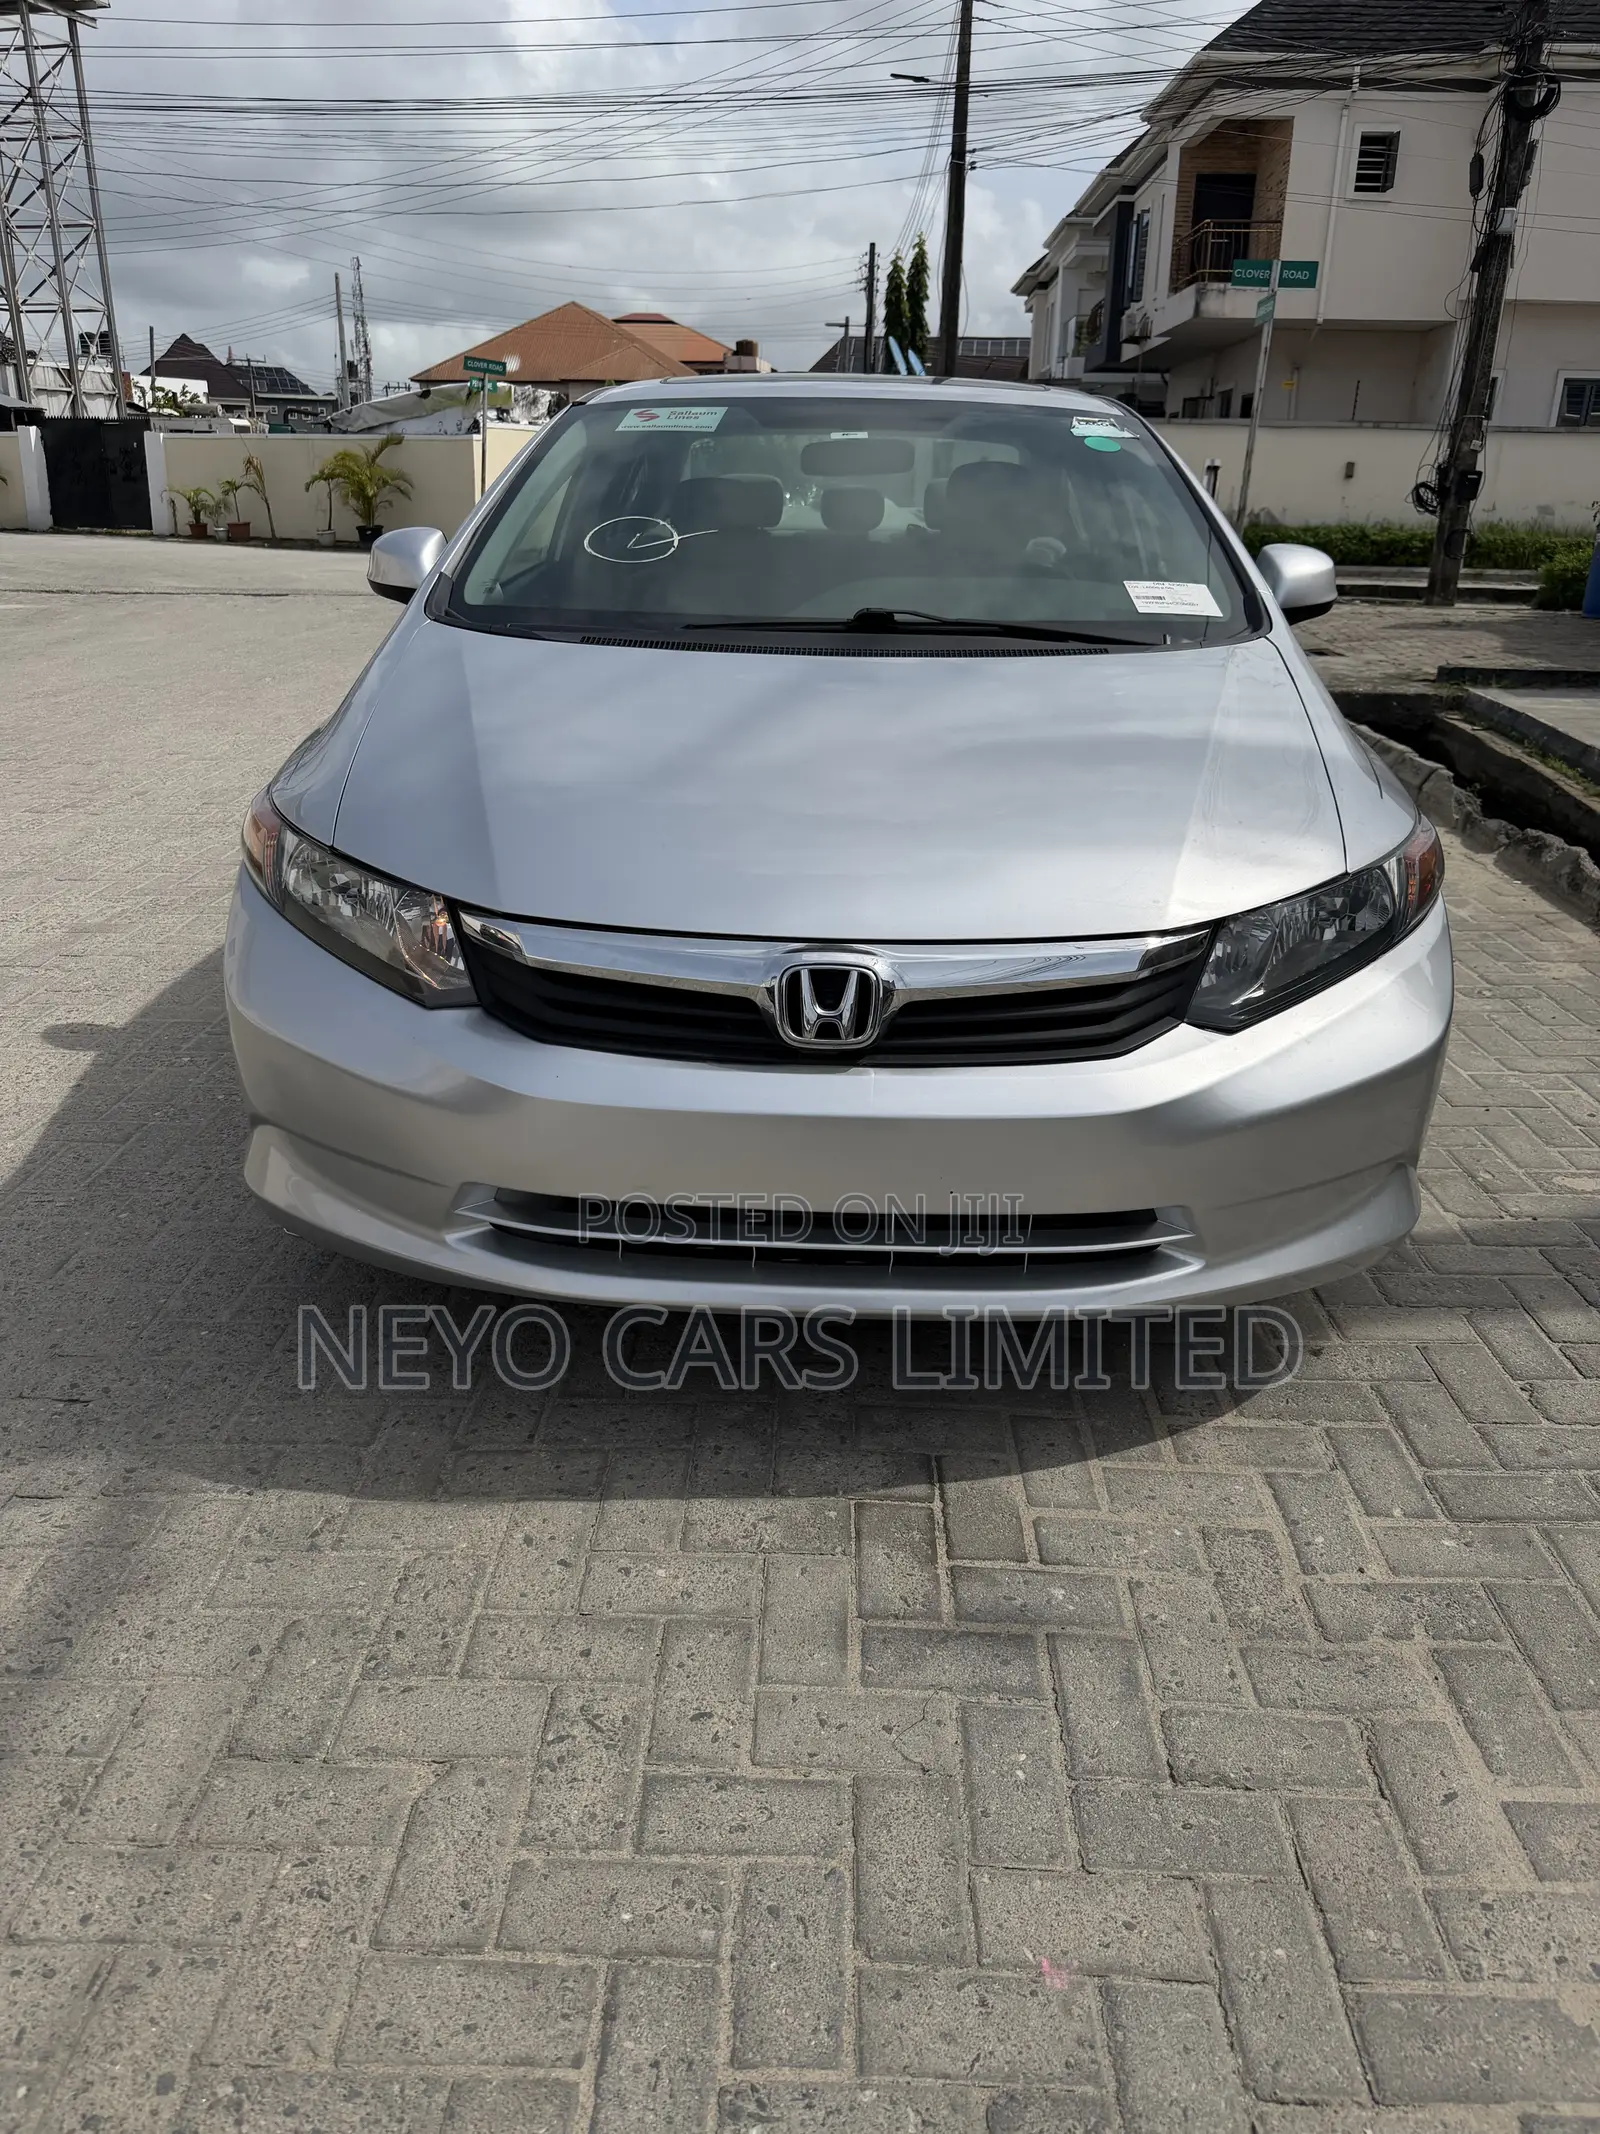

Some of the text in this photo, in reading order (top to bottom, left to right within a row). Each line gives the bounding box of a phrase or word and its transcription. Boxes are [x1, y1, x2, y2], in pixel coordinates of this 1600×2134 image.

[1234, 268, 1310, 280] CLOVER ROAD
[467, 360, 503, 371] CLOVER ROAD
